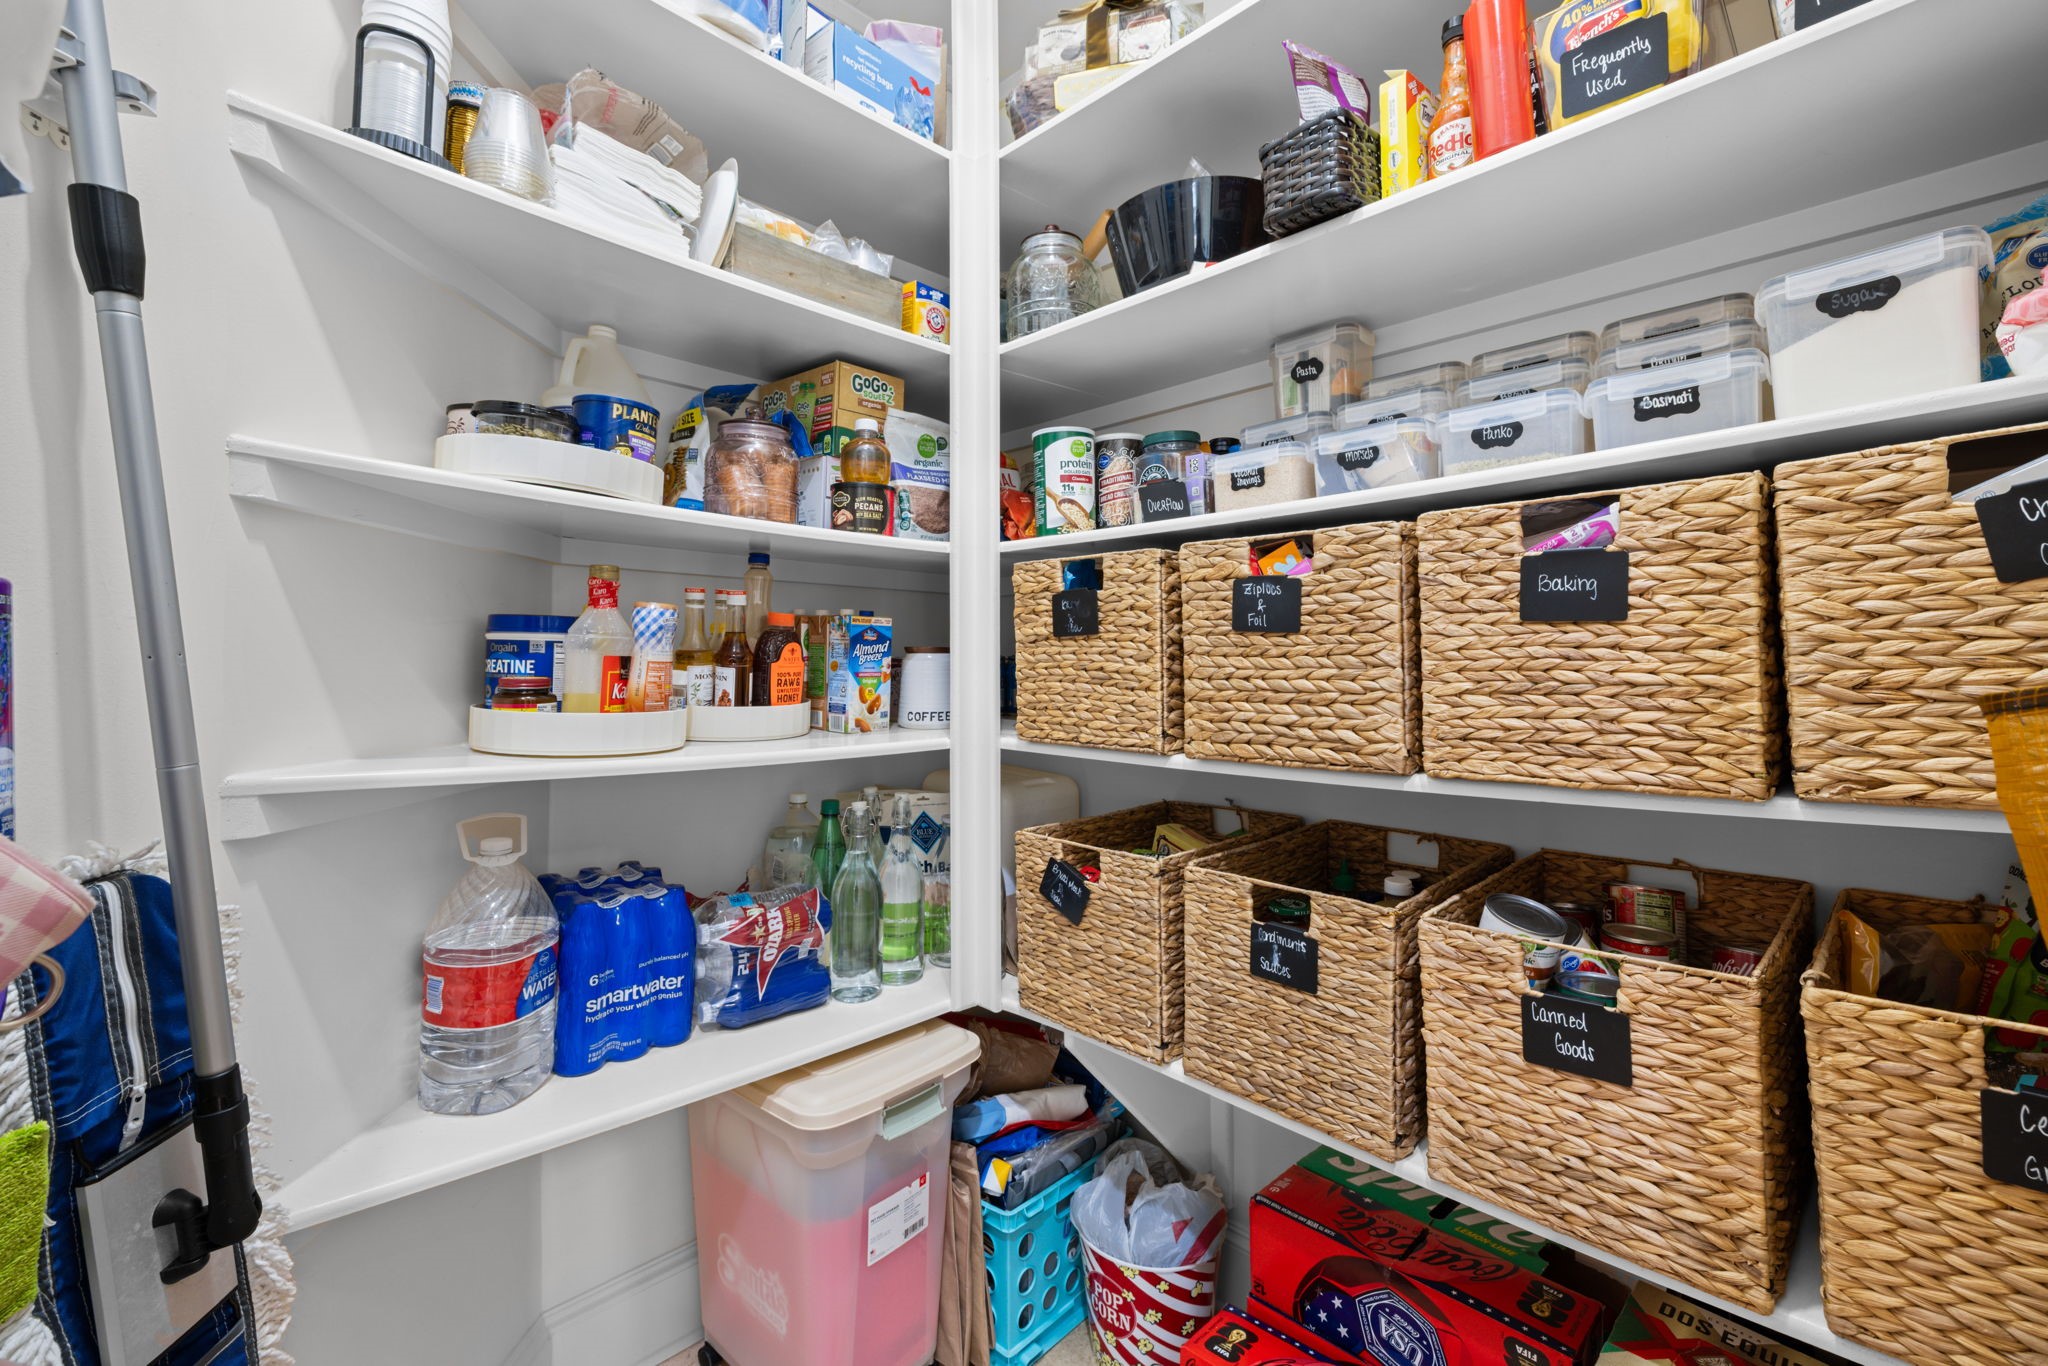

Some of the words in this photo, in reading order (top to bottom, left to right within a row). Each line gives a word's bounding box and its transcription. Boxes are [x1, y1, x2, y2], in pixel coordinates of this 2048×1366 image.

[1561, 2, 1593, 29] 40%
[1572, 36, 1651, 76] Frequently
[842, 54, 876, 81] recycling
[877, 73, 894, 91] bags
[1586, 69, 1627, 97] Used
[1296, 364, 1318, 377] Pasta
[852, 373, 889, 393] GoGo
[1642, 388, 1694, 410] Basmati
[612, 403, 659, 427] PLANTE
[1482, 426, 1513, 441] Panko
[1060, 459, 1093, 470] protein
[854, 502, 884, 512] PECANS
[1538, 573, 1598, 601] Baking
[1247, 613, 1267, 627] Foil
[852, 640, 890, 658] Almond
[858, 651, 883, 665] Breeze
[485, 658, 536, 674] REATINE
[776, 693, 800, 703] HONEY
[763, 906, 784, 962] OZARK
[589, 974, 599, 987] 6
[585, 974, 685, 1013] smartwater
[615, 1004, 635, 1013] your
[635, 999, 650, 1009] way
[657, 991, 683, 1001] genius
[1531, 1001, 1588, 1032] Canned
[1554, 1031, 1595, 1062] Goods
[1454, 1225, 1519, 1257] LEMON-LIME
[1093, 1279, 1124, 1311] POP
[1091, 1293, 1132, 1332] CORN
[1378, 1313, 1423, 1366] USA
[1658, 1301, 1714, 1336] DOS
[1720, 1330, 1800, 1366] EQUI
[1213, 1345, 1231, 1358] FIFA
[1515, 1344, 1538, 1363] FIFA
